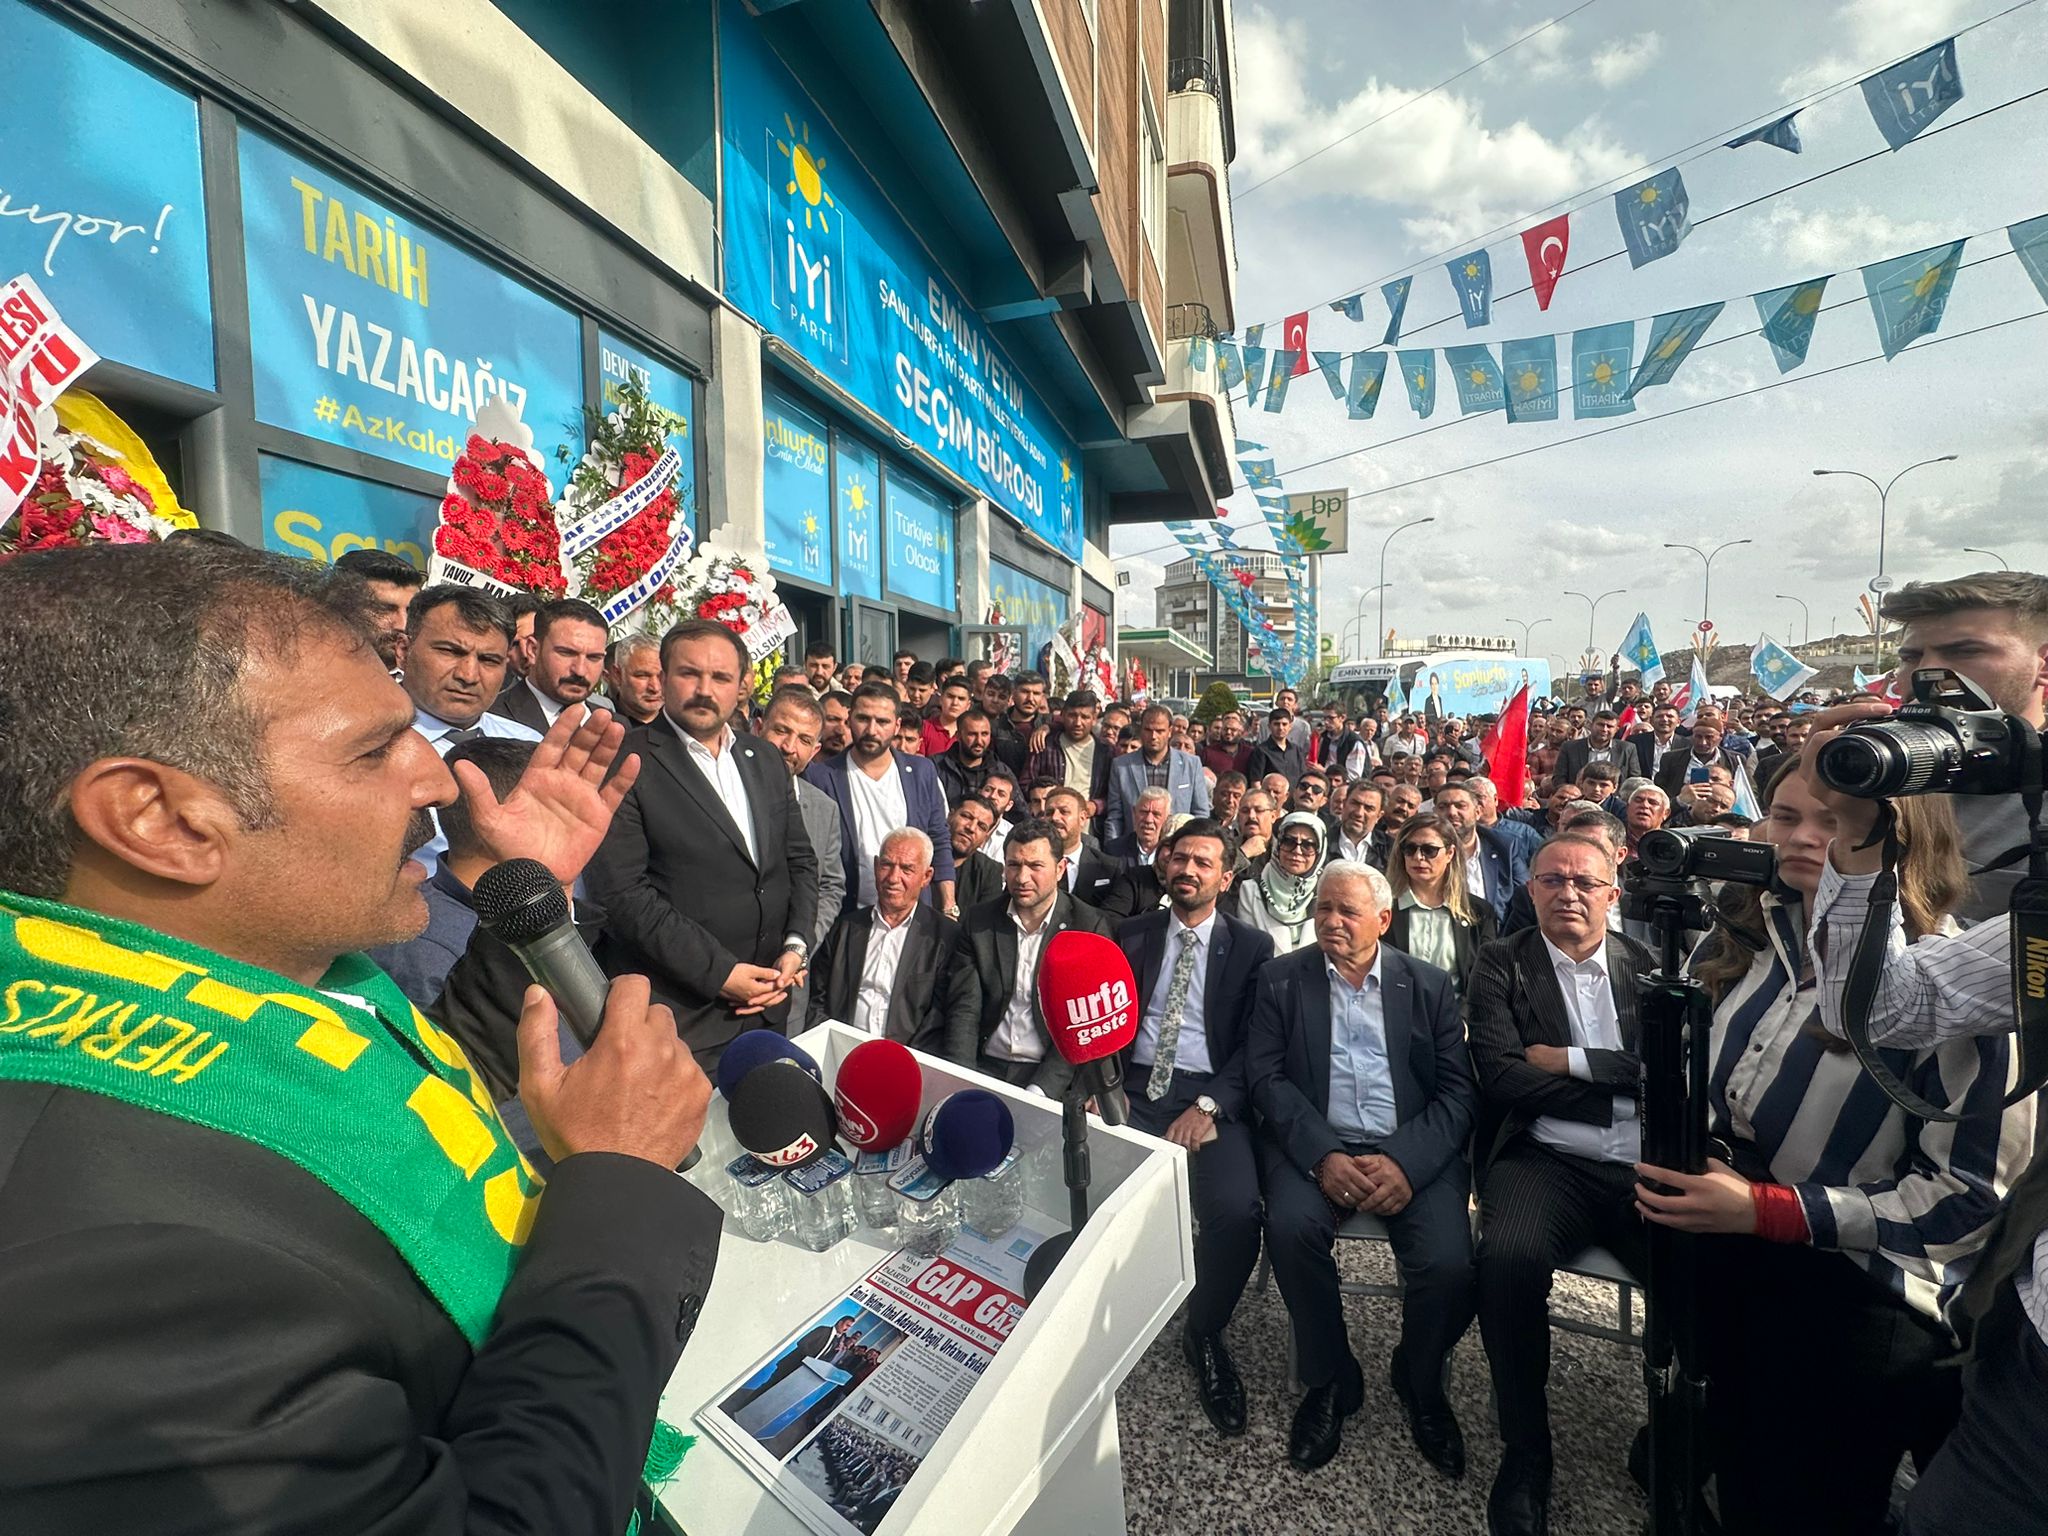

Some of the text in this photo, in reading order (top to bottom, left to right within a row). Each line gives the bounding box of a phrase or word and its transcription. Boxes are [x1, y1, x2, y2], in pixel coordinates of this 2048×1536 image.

[291, 176, 429, 307] TARİH
[786, 219, 832, 324] İYİ
[790, 309, 834, 353] PARTİ
[879, 279, 944, 364] ŞANLIURFA
[958, 368, 985, 401] PARTİ
[928, 277, 1023, 418] EMİN YETİM
[603, 347, 651, 394] DEVLTE
[313, 395, 462, 460] #AzKald
[895, 352, 1043, 517] SEÇİM BÜROSU
[1312, 495, 1342, 518] bp
[564, 503, 641, 556] YAVUZ
[848, 522, 868, 562] İYİ
[895, 511, 933, 547] Türkiye
[442, 563, 475, 586] YAVUZ
[649, 530, 690, 587] OLSUN
[804, 541, 819, 567] İYİ
[905, 544, 941, 575] Olacak
[750, 632, 783, 660] OLSUN
[1338, 664, 1397, 677] EMİN YETİM
[1901, 706, 1932, 714] Nikon
[2026, 936, 2048, 998] Nikon
[1065, 979, 1130, 1025] urfa
[1077, 1013, 1128, 1046] gaste
[873, 1275, 892, 1289] YEREL
[912, 1296, 931, 1310] YAYIN
[916, 1264, 982, 1308] GAP
[850, 1285, 869, 1303] Emin
[865, 1293, 883, 1313] Yetim:
[894, 1312, 923, 1339] Adaylara
[939, 1336, 968, 1363] Urfa'nın
